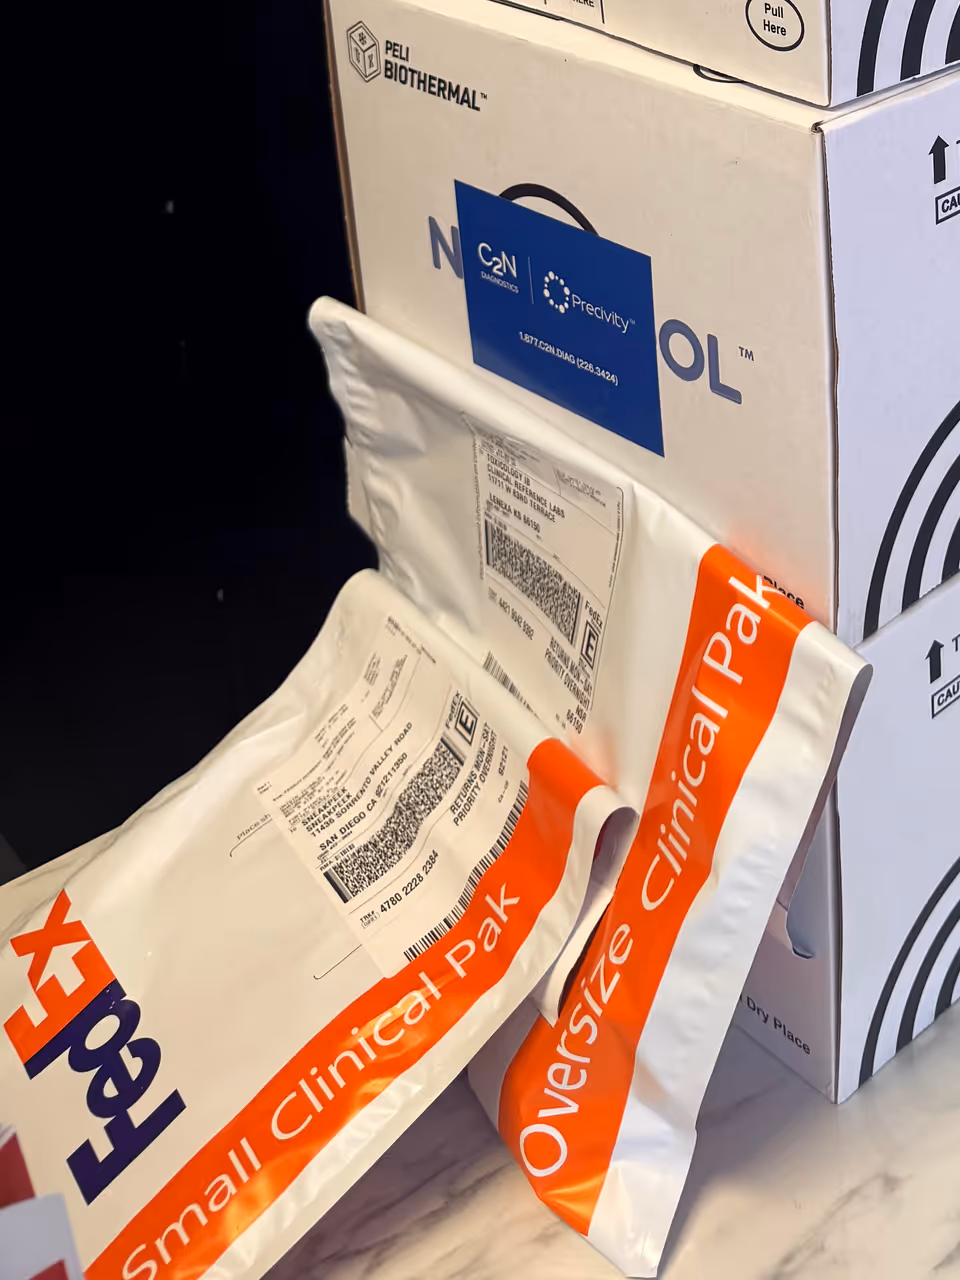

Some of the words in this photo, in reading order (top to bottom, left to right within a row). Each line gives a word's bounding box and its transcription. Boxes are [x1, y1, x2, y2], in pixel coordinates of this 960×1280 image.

[763, 2, 785, 20] Pull
[762, 20, 787, 37] Here
[385, 40, 409, 62] PELI
[481, 270, 519, 294] DIAGNOSTICS
[487, 453, 522, 481] TOXICOLOGY
[487, 463, 513, 485] CLINICAL
[515, 480, 547, 507] REFERENCE
[549, 502, 565, 518] LABS
[489, 492, 512, 514] LENEXA
[530, 499, 555, 522] TERRACE
[320, 833, 338, 851] SAN
[339, 811, 366, 835] DIEGO
[380, 893, 402, 913] 4780
[402, 873, 423, 896] 2228
[518, 922, 634, 1179] Oversize
[640, 686, 729, 912] Clinical
[703, 574, 785, 685] Pak
[747, 995, 769, 1024] Dry
[774, 1017, 810, 1055] Place
[3, 888, 187, 1206] FedEx
[121, 1137, 261, 1280] Small
[270, 971, 442, 1141] Clinical
[444, 882, 521, 978] Pak
